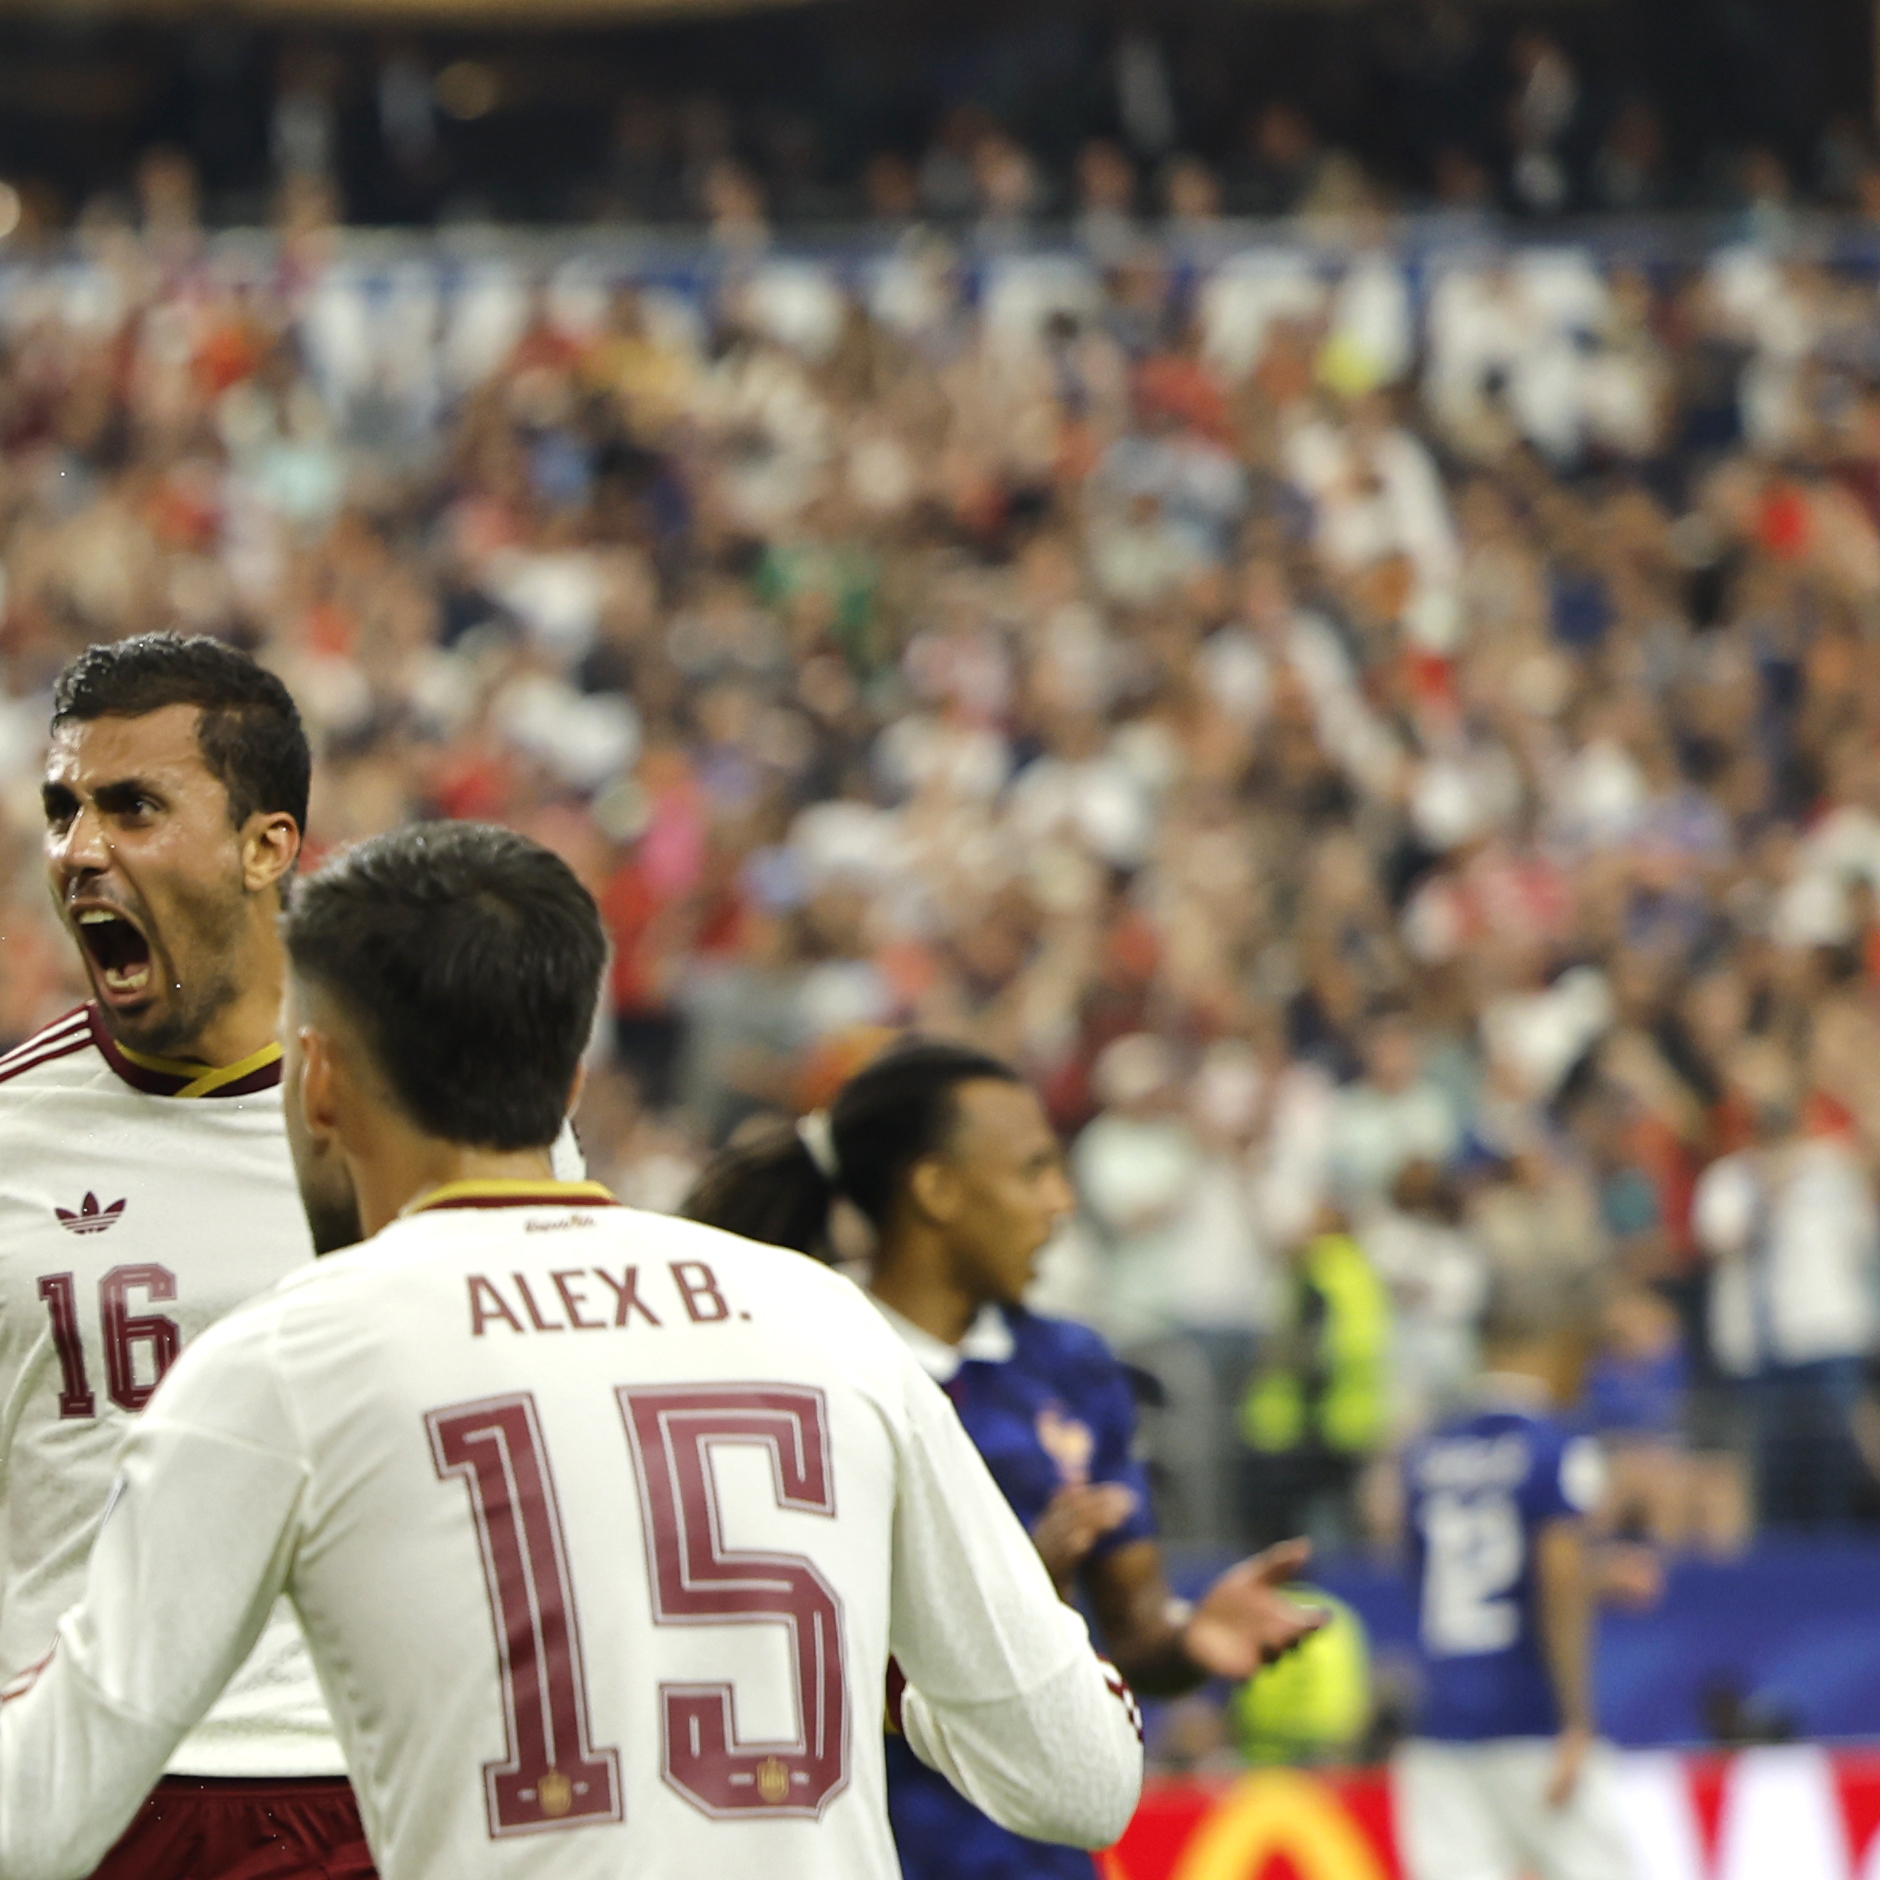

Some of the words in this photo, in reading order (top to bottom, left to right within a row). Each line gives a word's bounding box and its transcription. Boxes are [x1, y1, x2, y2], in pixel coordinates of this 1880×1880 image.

[36, 1263, 180, 1420] 16
[466, 1264, 664, 1337] ALEX
[667, 1260, 752, 1325] B.
[424, 1379, 853, 1840] 15
